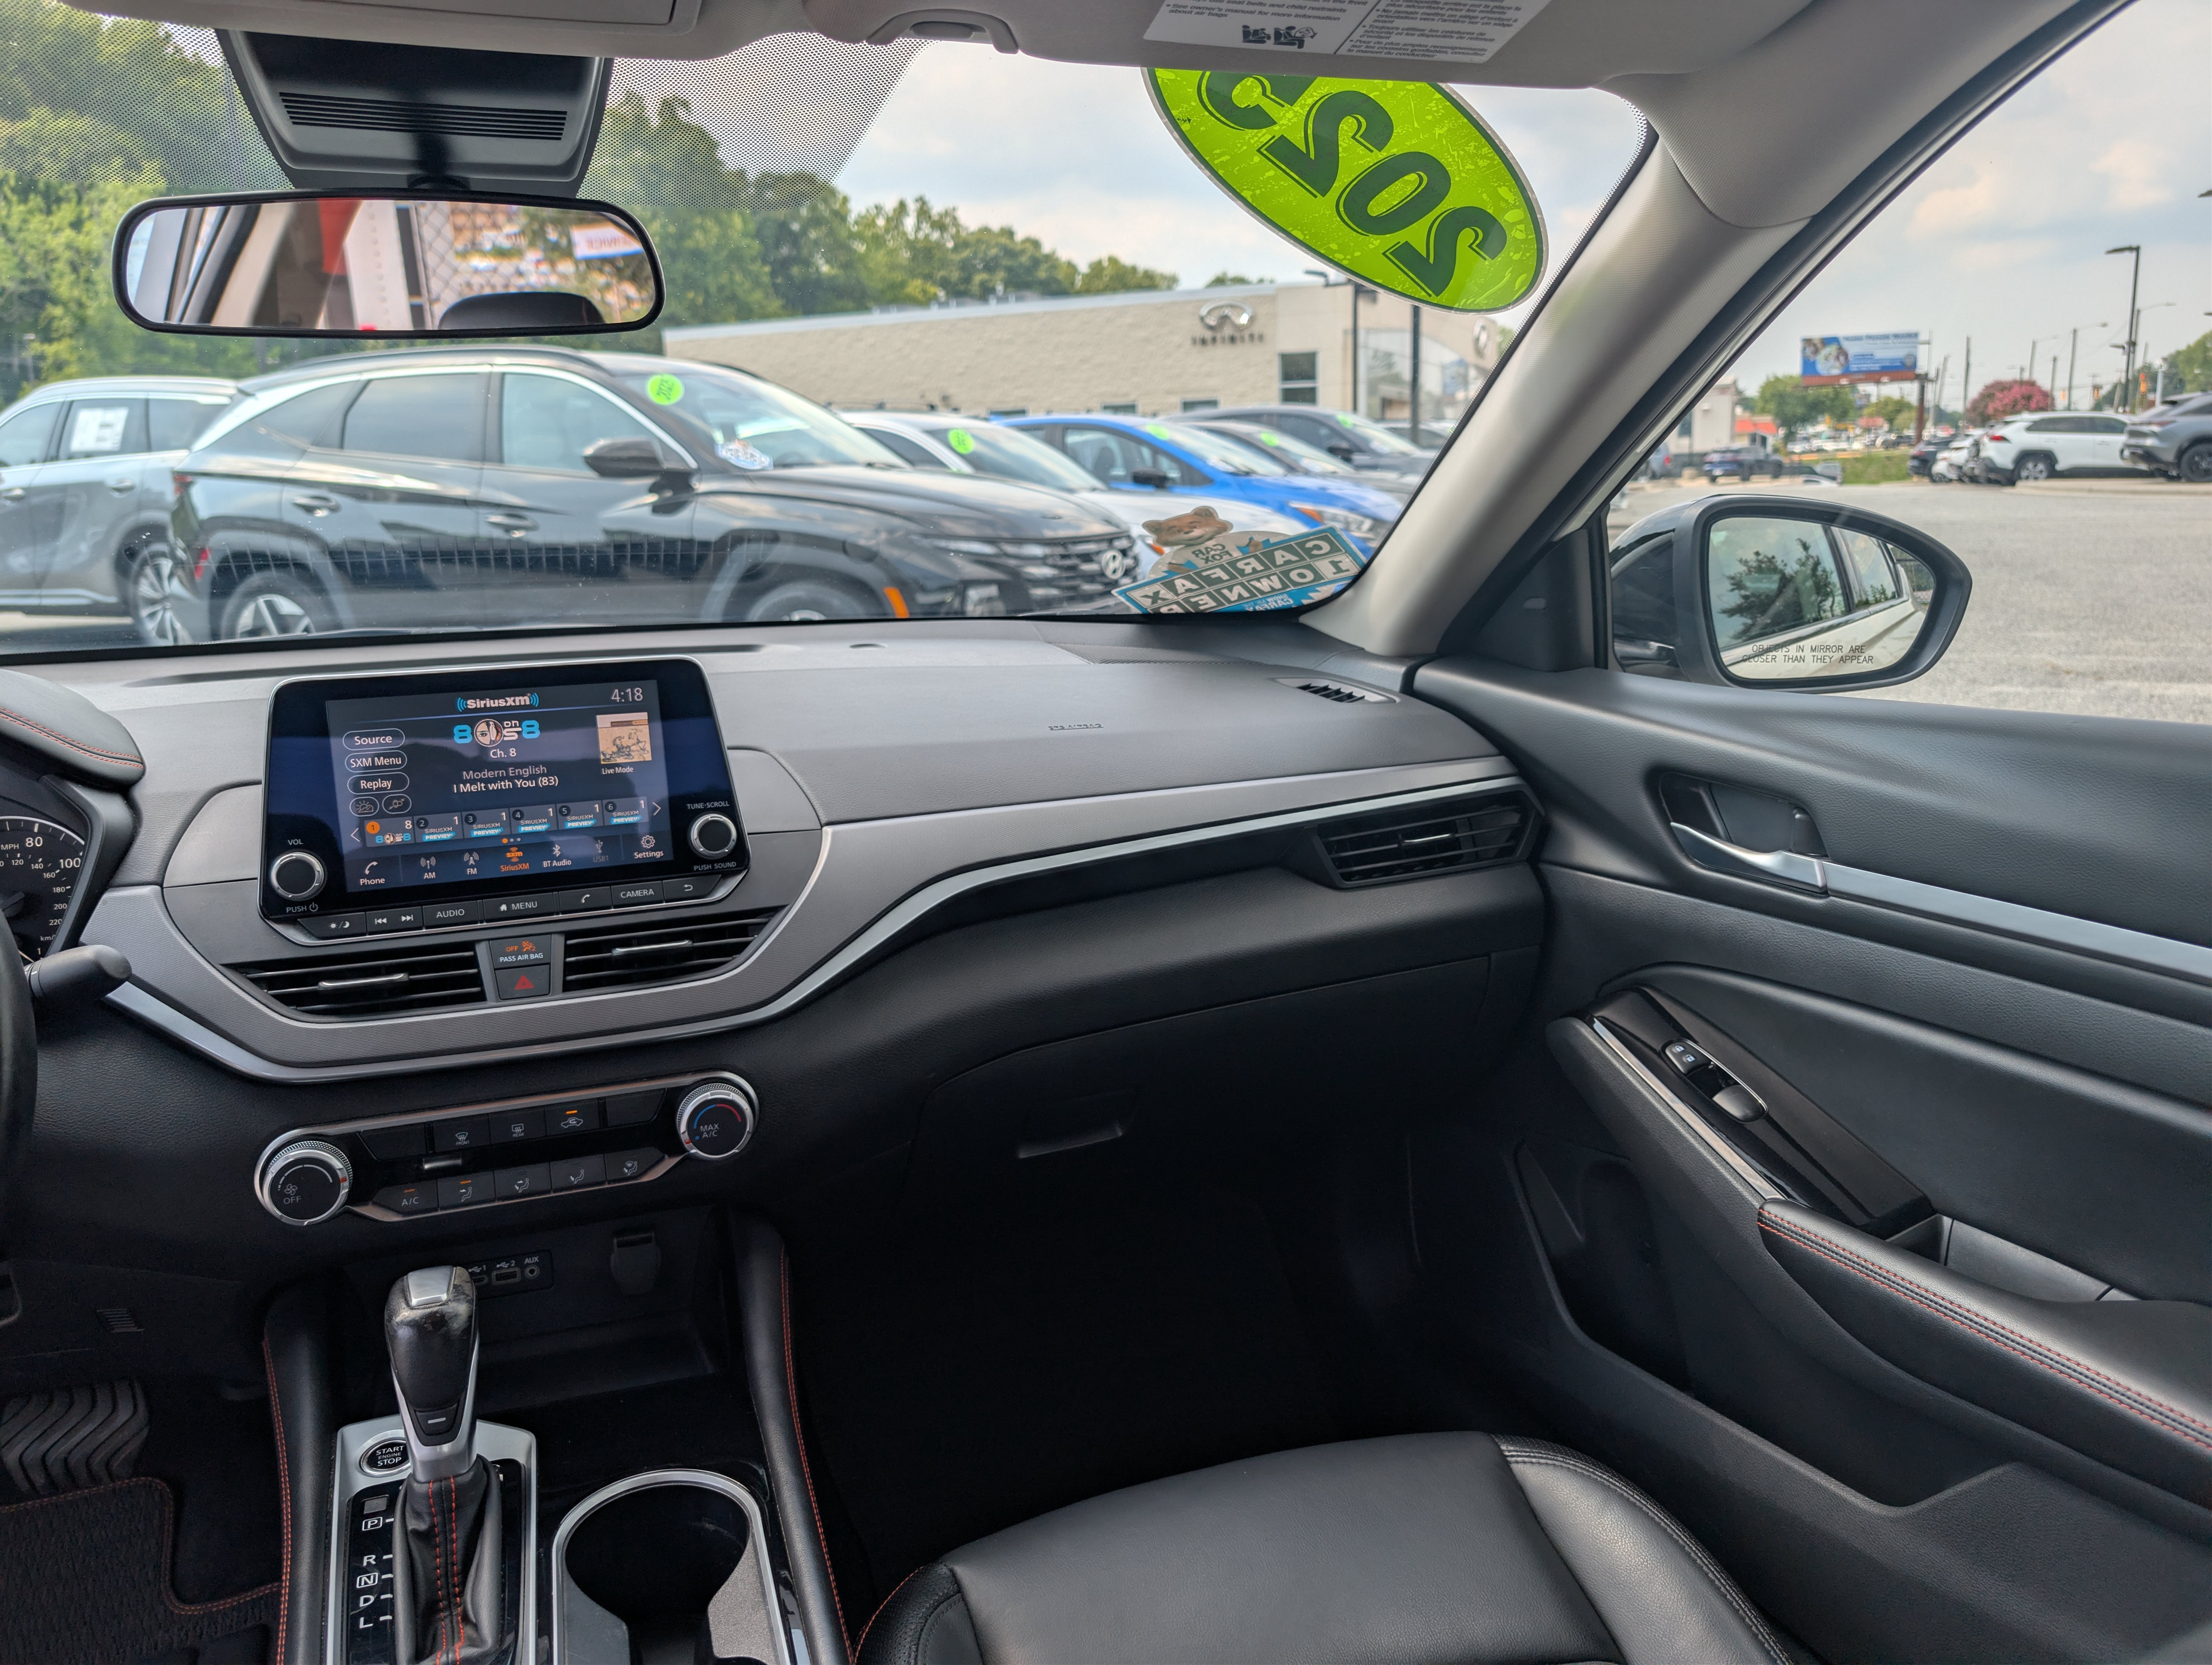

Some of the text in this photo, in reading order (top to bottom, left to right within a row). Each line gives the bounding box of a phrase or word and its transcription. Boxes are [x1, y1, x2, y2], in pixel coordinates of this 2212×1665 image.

[1752, 644, 1865, 653] OBJECTS IN MIRROR ARE
[1742, 655, 1874, 664] CLOSER THAN THEY APPEAR
[611, 687, 643, 703] 4:18
[354, 735, 392, 745] Source
[490, 748, 517, 758] Ch. 8
[350, 756, 402, 768] SXM Menu
[463, 765, 547, 780] Modern English
[360, 779, 392, 790] Replay
[460, 781, 486, 792] Melt
[488, 779, 513, 790] with
[515, 779, 536, 788] You
[538, 776, 559, 787] (83)
[594, 804, 599, 812] 1
[640, 800, 644, 809] 1
[502, 812, 506, 821] 1
[549, 808, 553, 816] 1
[405, 820, 412, 829] 8
[454, 816, 458, 825] 1
[25, 836, 43, 848] 80
[634, 851, 664, 859] Settings
[59, 858, 81, 868] 100
[501, 863, 529, 872] SiriusXM
[360, 877, 386, 885] Phone
[620, 889, 655, 898] CAMERA
[286, 905, 307, 913] PUSH
[512, 901, 538, 910] MENU
[436, 909, 465, 918] AUDIO
[700, 1123, 719, 1132] MAX
[702, 1130, 718, 1138] A/C
[283, 1196, 301, 1204] OFF
[402, 1197, 419, 1206] A/C
[376, 1446, 404, 1455] START
[377, 1457, 402, 1466] STOP
[363, 1555, 376, 1566] R
[360, 1595, 374, 1606] D
[359, 1617, 373, 1628] L
